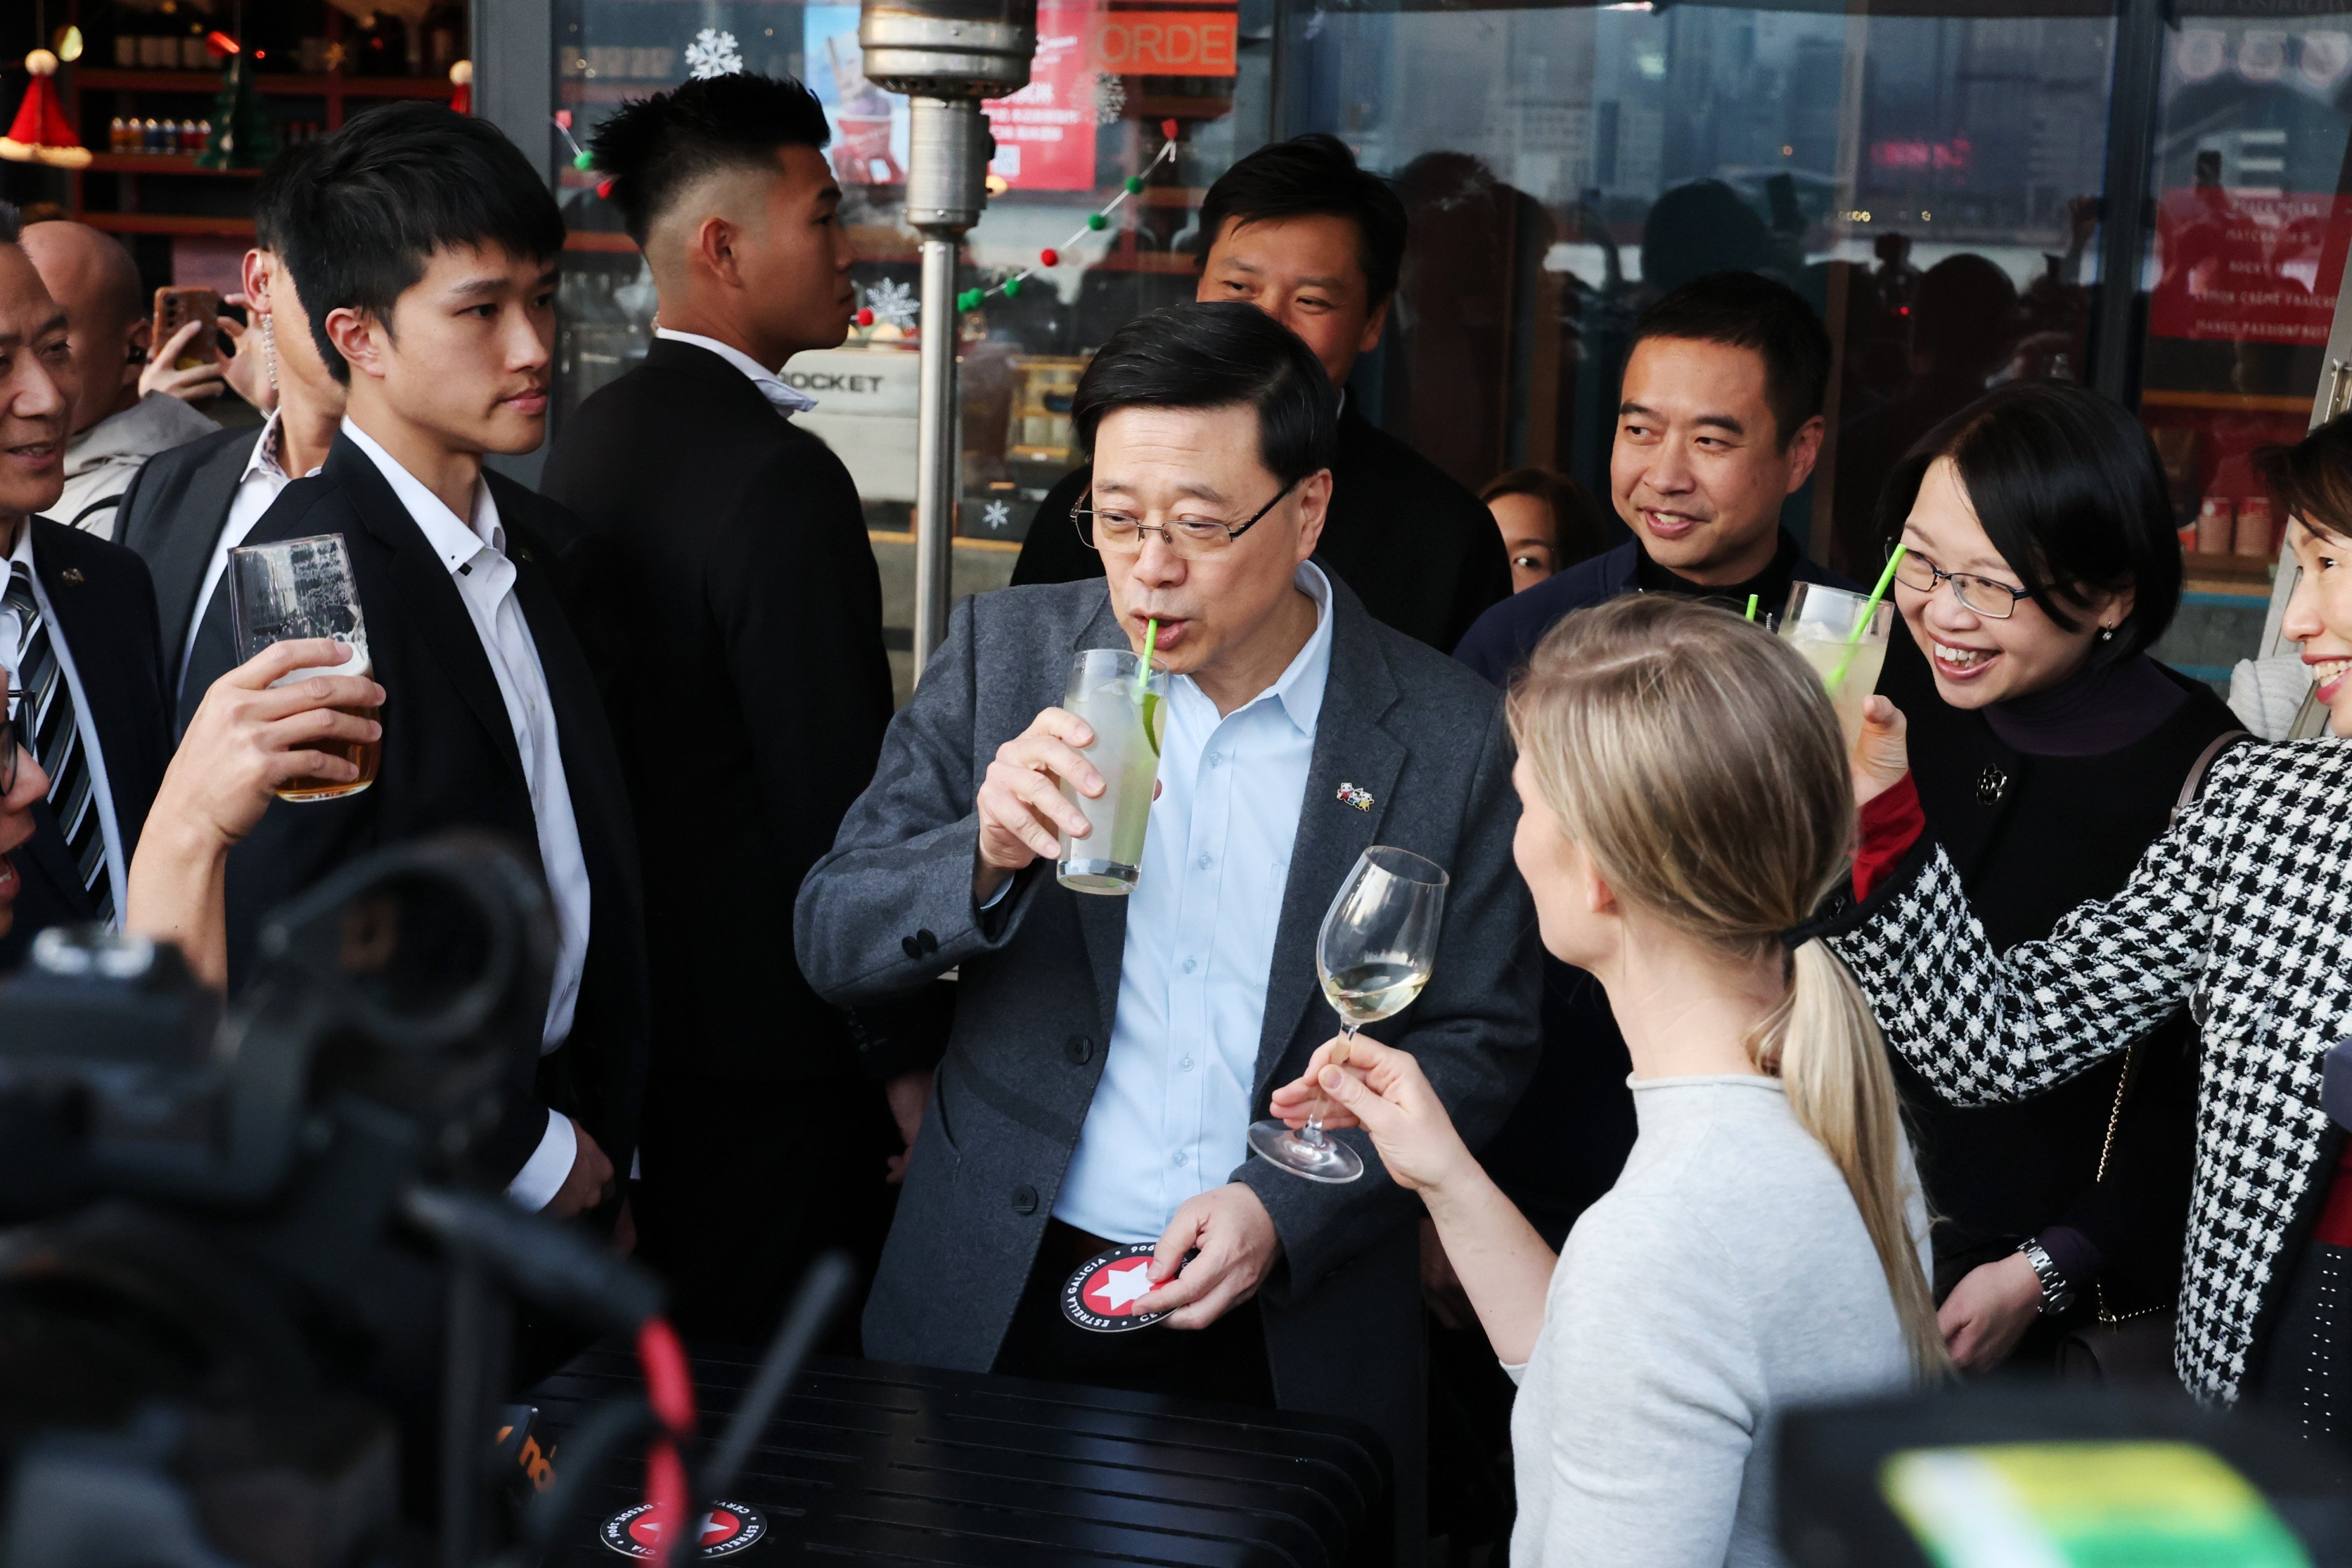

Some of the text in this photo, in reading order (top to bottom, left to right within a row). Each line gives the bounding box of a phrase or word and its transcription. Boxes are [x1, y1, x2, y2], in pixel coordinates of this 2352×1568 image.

[1098, 24, 1238, 64] ORDE
[1067, 1258, 1111, 1327] ESTRELLA GALICIA
[615, 1504, 654, 1522] DESDE
[607, 1522, 621, 1538] 1906
[703, 1524, 759, 1554] ESTRELLA
